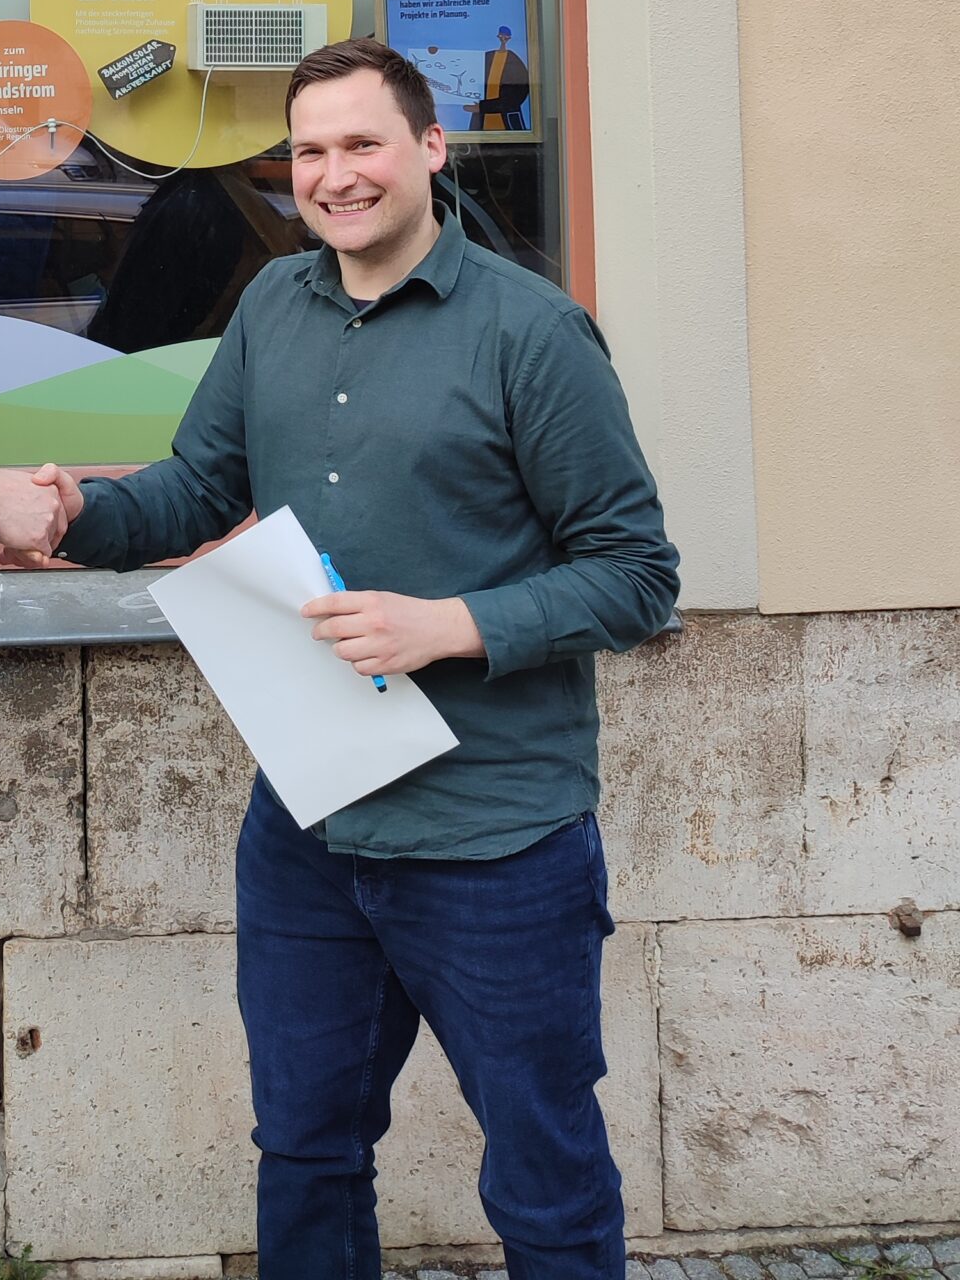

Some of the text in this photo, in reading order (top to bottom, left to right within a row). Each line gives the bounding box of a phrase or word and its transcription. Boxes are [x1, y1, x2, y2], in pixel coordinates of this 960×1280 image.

[400, 0, 421, 8] haben
[422, 0, 434, 8] wir
[400, 9, 470, 20] Projekte in Planung.
[3, 47, 25, 55] zum
[111, 53, 155, 82] MOMENTAN
